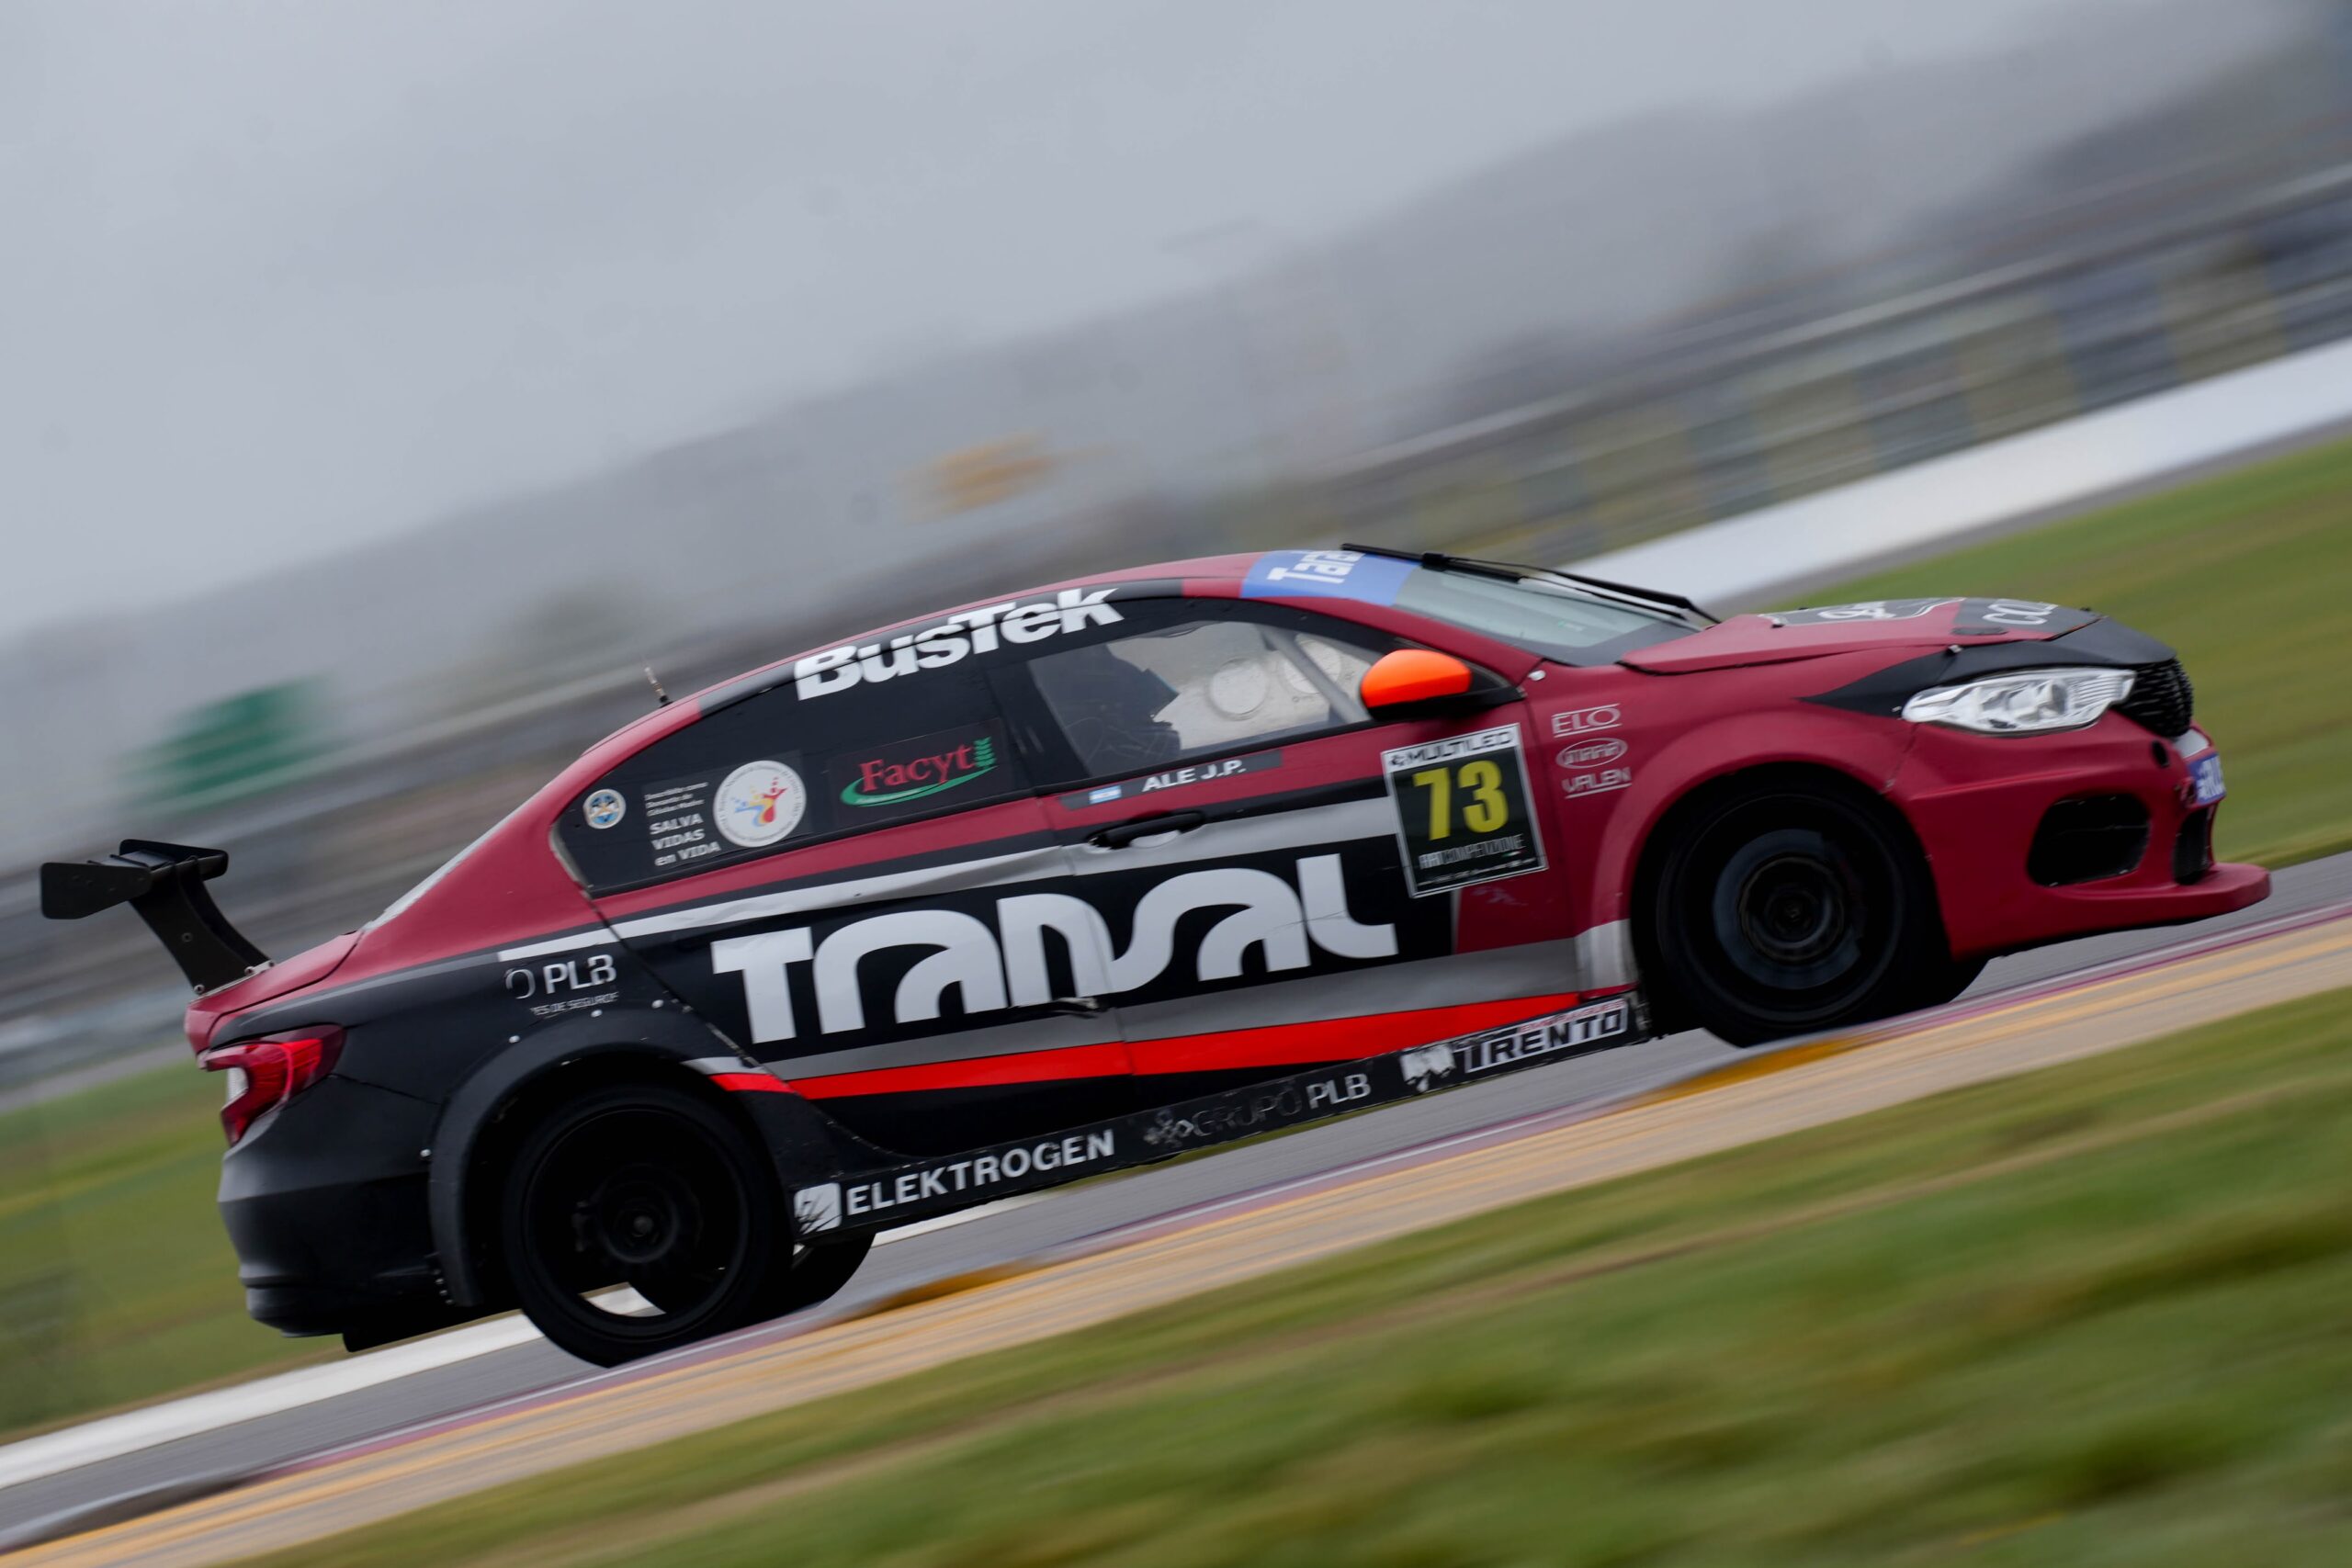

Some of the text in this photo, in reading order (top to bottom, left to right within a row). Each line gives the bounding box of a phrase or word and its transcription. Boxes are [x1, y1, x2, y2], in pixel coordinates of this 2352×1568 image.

[859, 744, 975, 792] Facyt
[1142, 760, 1247, 792] ALE J.P.
[1412, 760, 1509, 840] 73
[650, 813, 704, 835] SALVA
[651, 829, 706, 850] VIDAS
[677, 841, 721, 860] VIDA
[543, 953, 617, 994] PLB
[1453, 1009, 1623, 1069] TRENTO
[1306, 1073, 1372, 1110] PLB
[846, 1129, 1114, 1216] ELEKTROGEN
